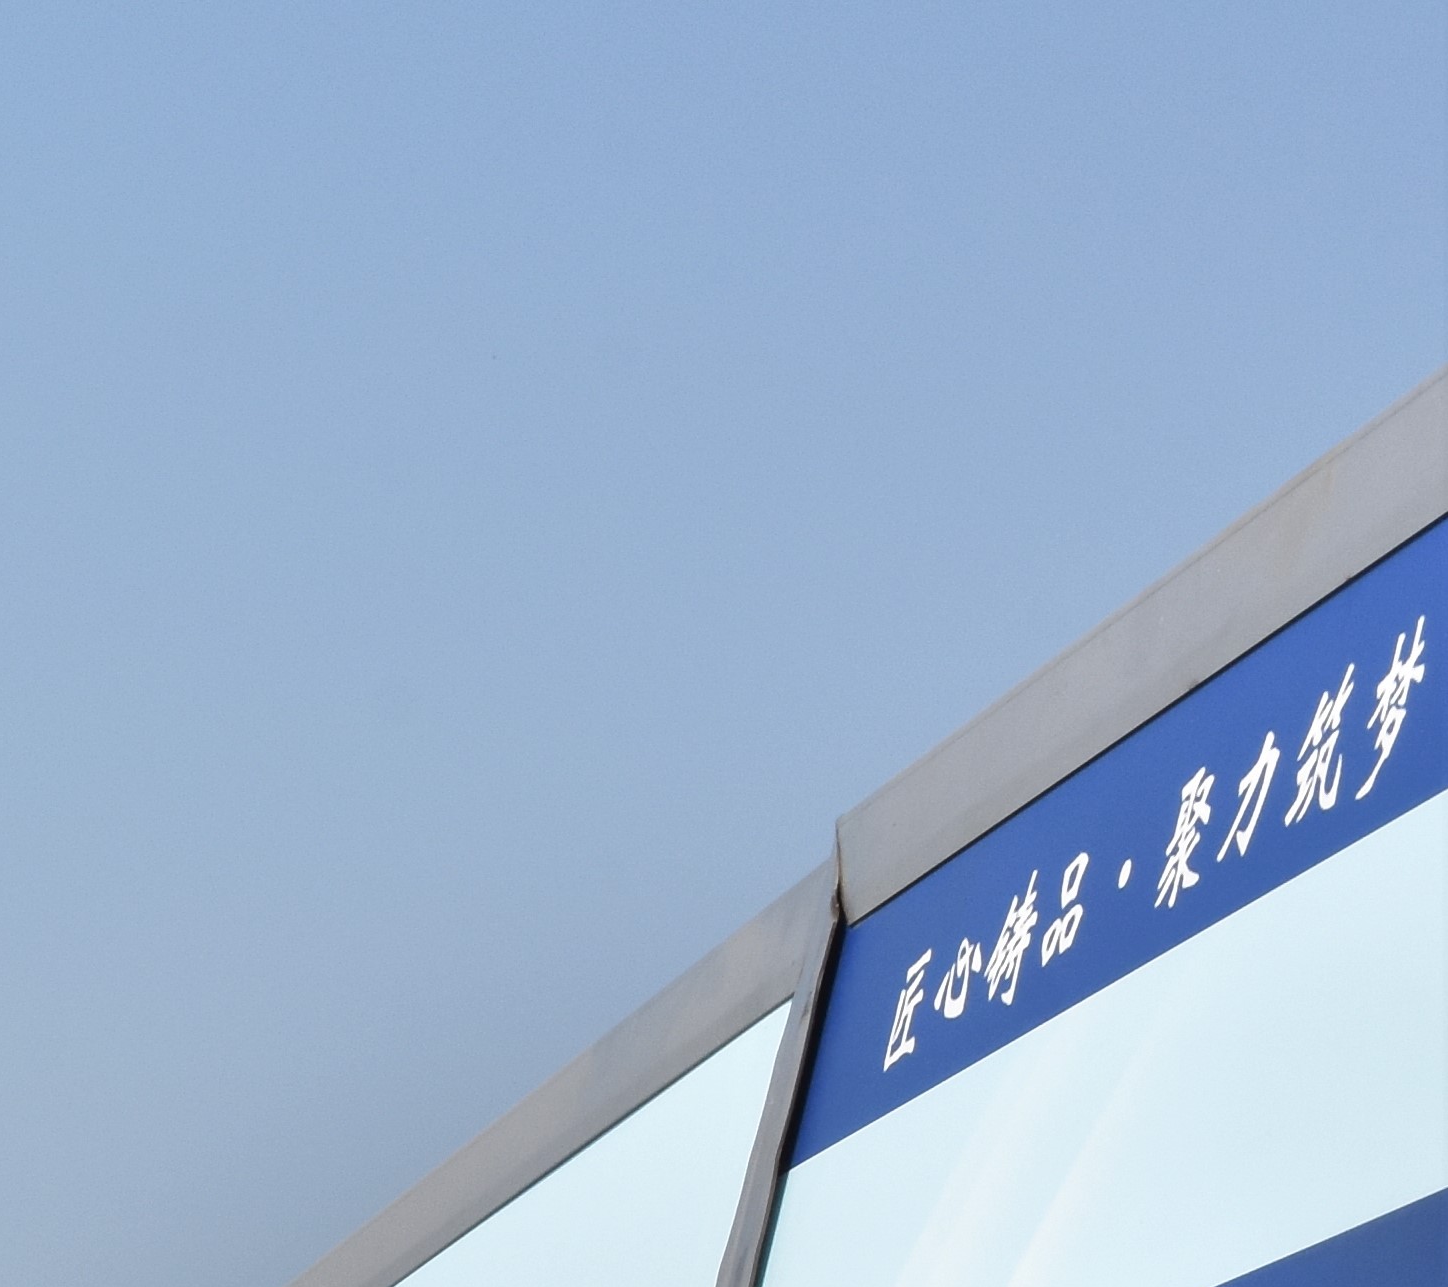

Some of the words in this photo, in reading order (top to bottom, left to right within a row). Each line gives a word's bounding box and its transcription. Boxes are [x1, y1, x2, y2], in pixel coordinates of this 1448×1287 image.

[883, 614, 1426, 1072] 匠心铸品·聚力筑梦
